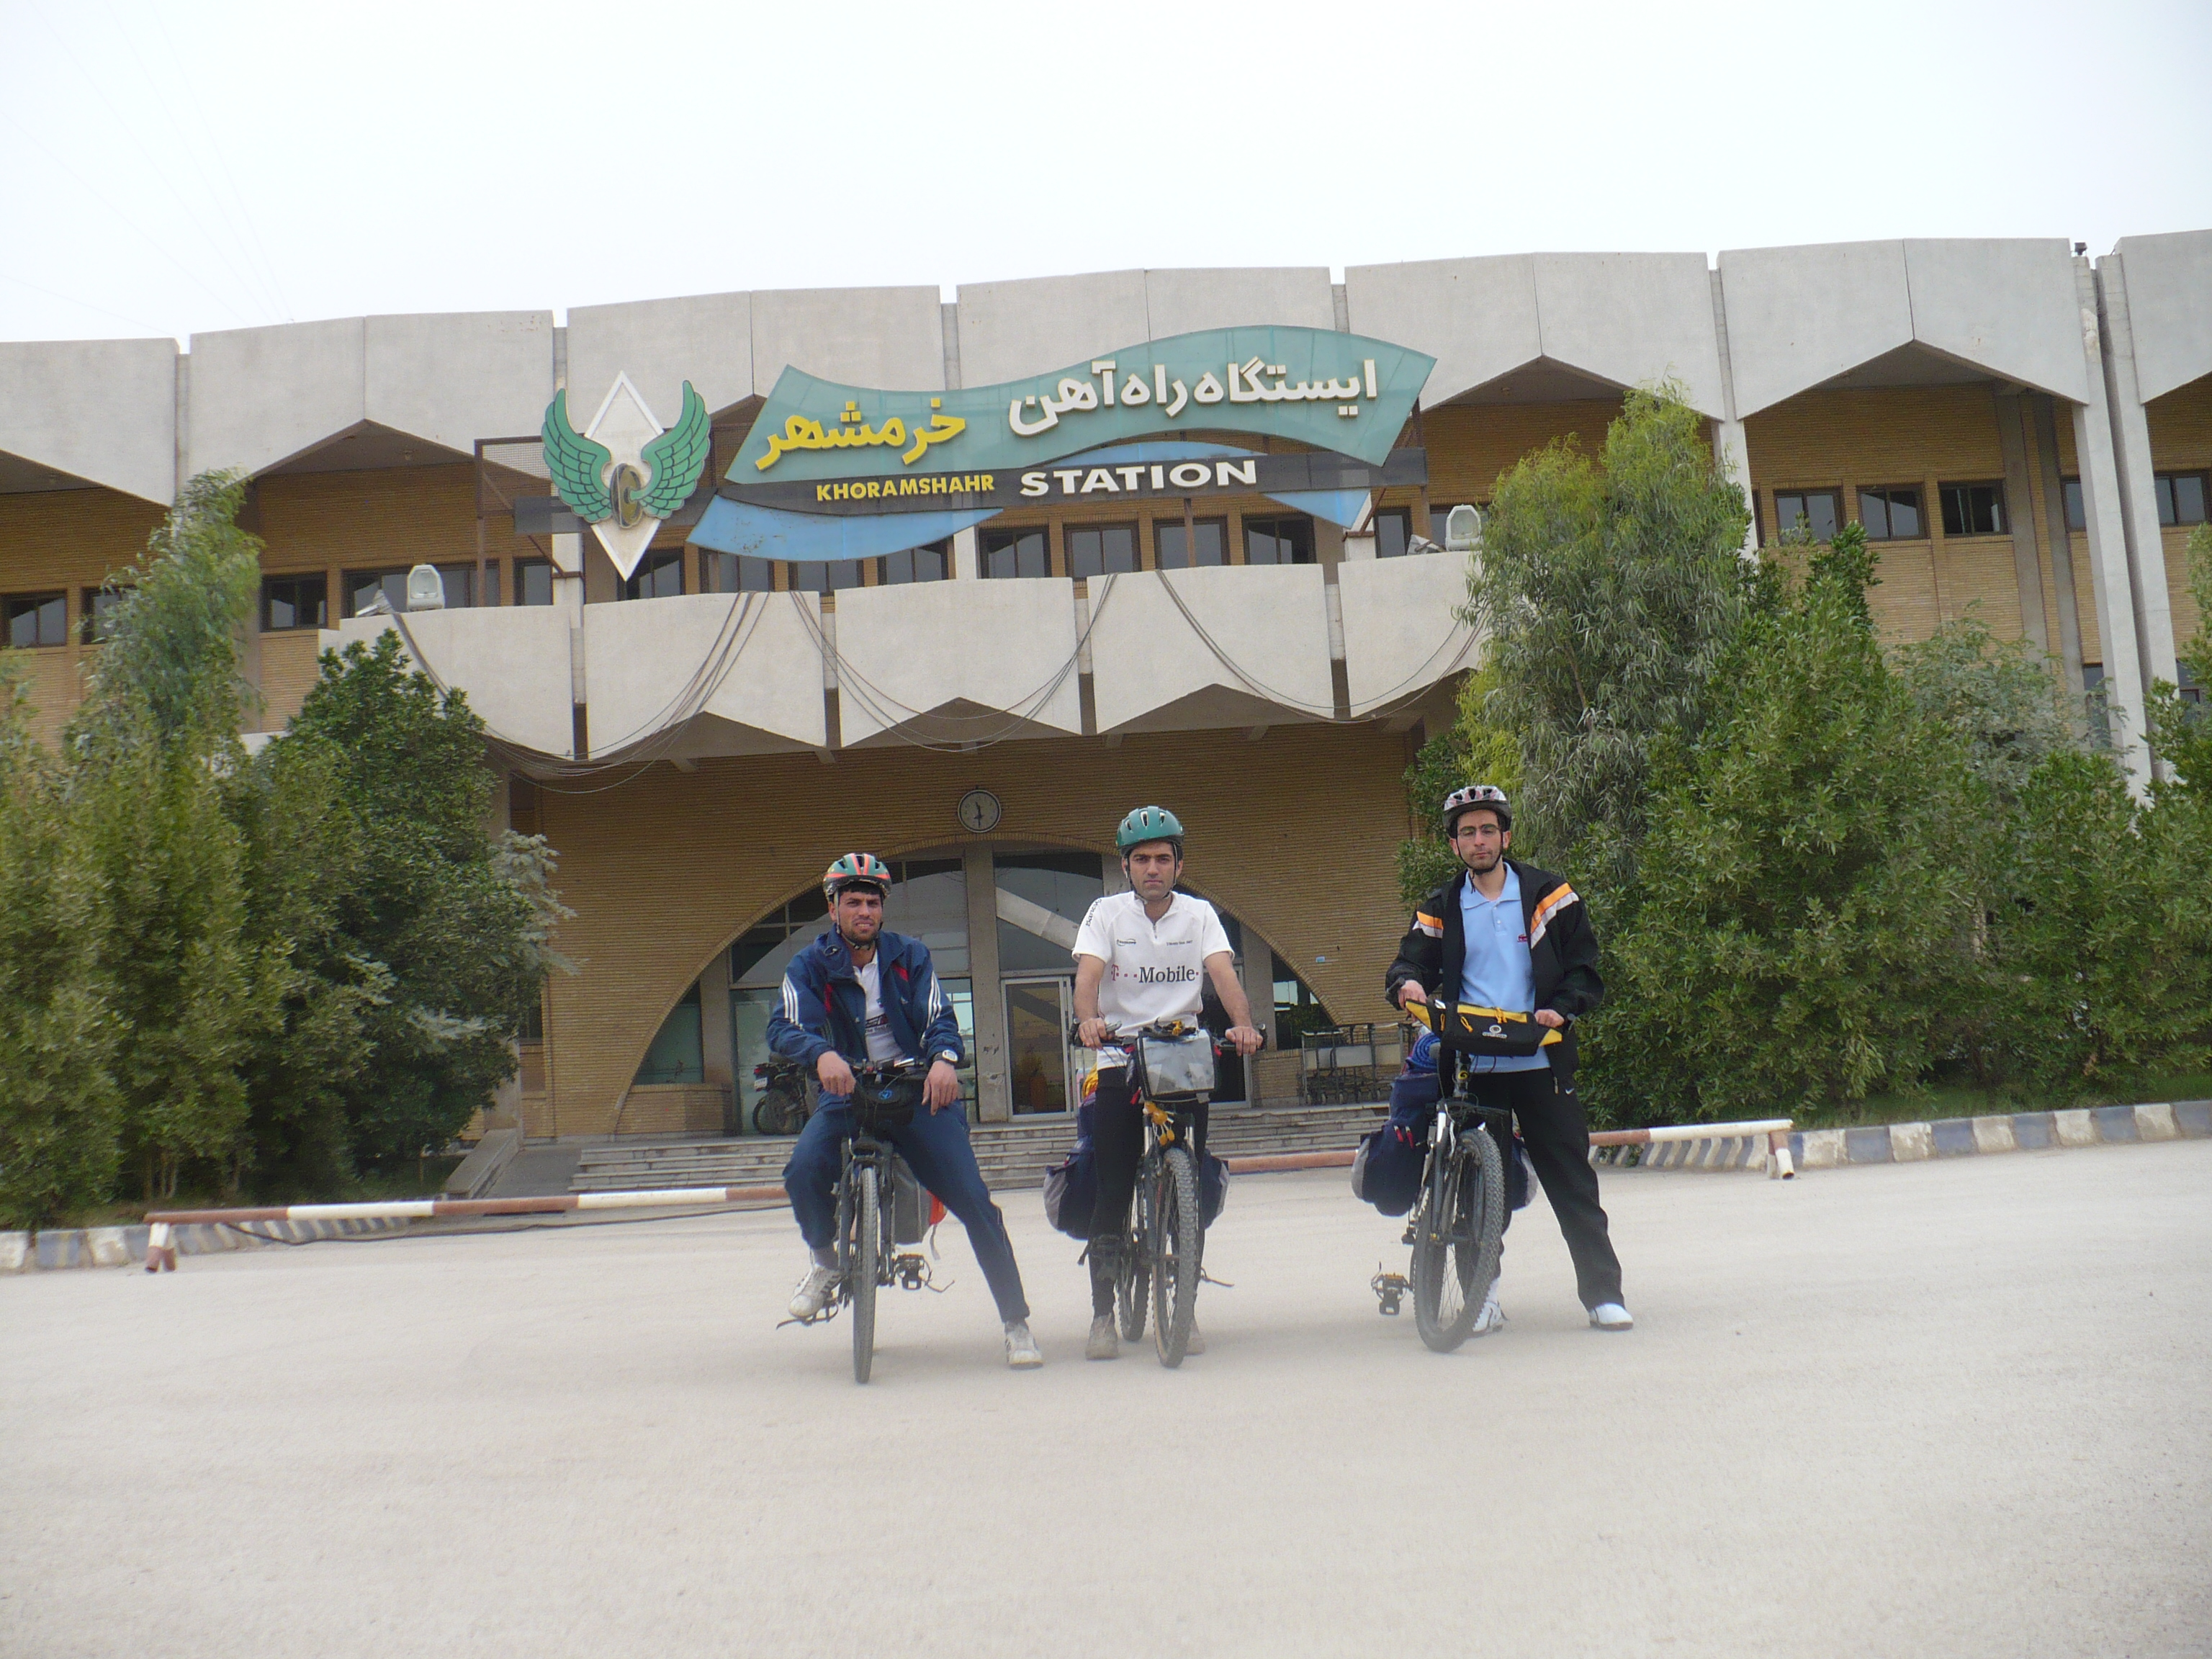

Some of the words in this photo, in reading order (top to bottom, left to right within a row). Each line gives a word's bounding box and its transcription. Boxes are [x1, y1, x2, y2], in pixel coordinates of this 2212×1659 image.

[1008, 359, 1117, 437] آهن
[1120, 363, 1189, 418] راه
[1193, 356, 1377, 418] ایستگاه
[755, 397, 966, 471] خرمشهر
[816, 474, 995, 502] KHORAMSHAHR
[1020, 459, 1257, 497] STATION
[1138, 965, 1195, 984] Mobile
